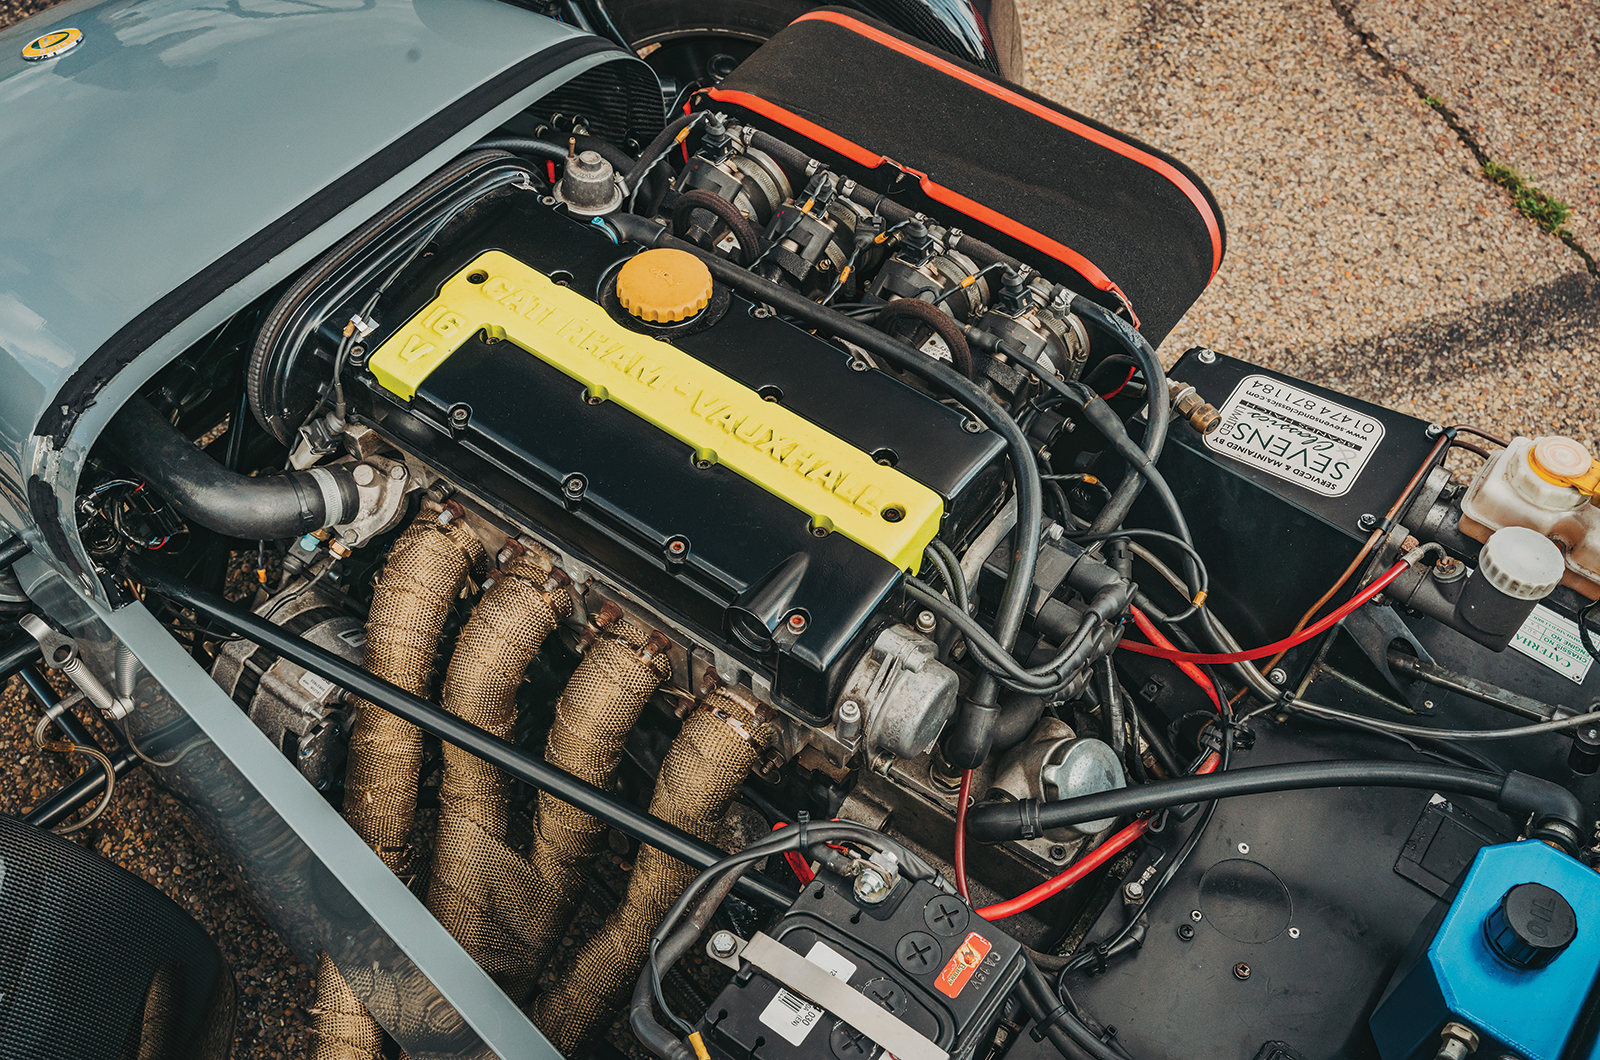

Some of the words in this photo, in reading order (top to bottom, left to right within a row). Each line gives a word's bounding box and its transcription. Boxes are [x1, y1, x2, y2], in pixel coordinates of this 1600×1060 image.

[421, 304, 467, 339] 16
[399, 334, 435, 363] V
[479, 276, 674, 391] CATERHAM
[690, 389, 882, 517] VAUXHALL
[1252, 380, 1317, 411] 871184
[1219, 405, 1247, 436] LIMITED
[1246, 390, 1368, 442] www.sevensandclassics.com
[1320, 406, 1375, 434] 01474
[1213, 436, 1225, 444] BY
[1247, 412, 1335, 452] Classics
[1226, 442, 1283, 468] MAINTAINED
[1232, 422, 1350, 481] SEVENS
[1293, 468, 1337, 490] SERVICED
[1516, 633, 1571, 668] CATERHA
[1556, 644, 1588, 664] CHASSIS
[1565, 640, 1590, 657] ENGINE
[1527, 898, 1556, 938] OIL
